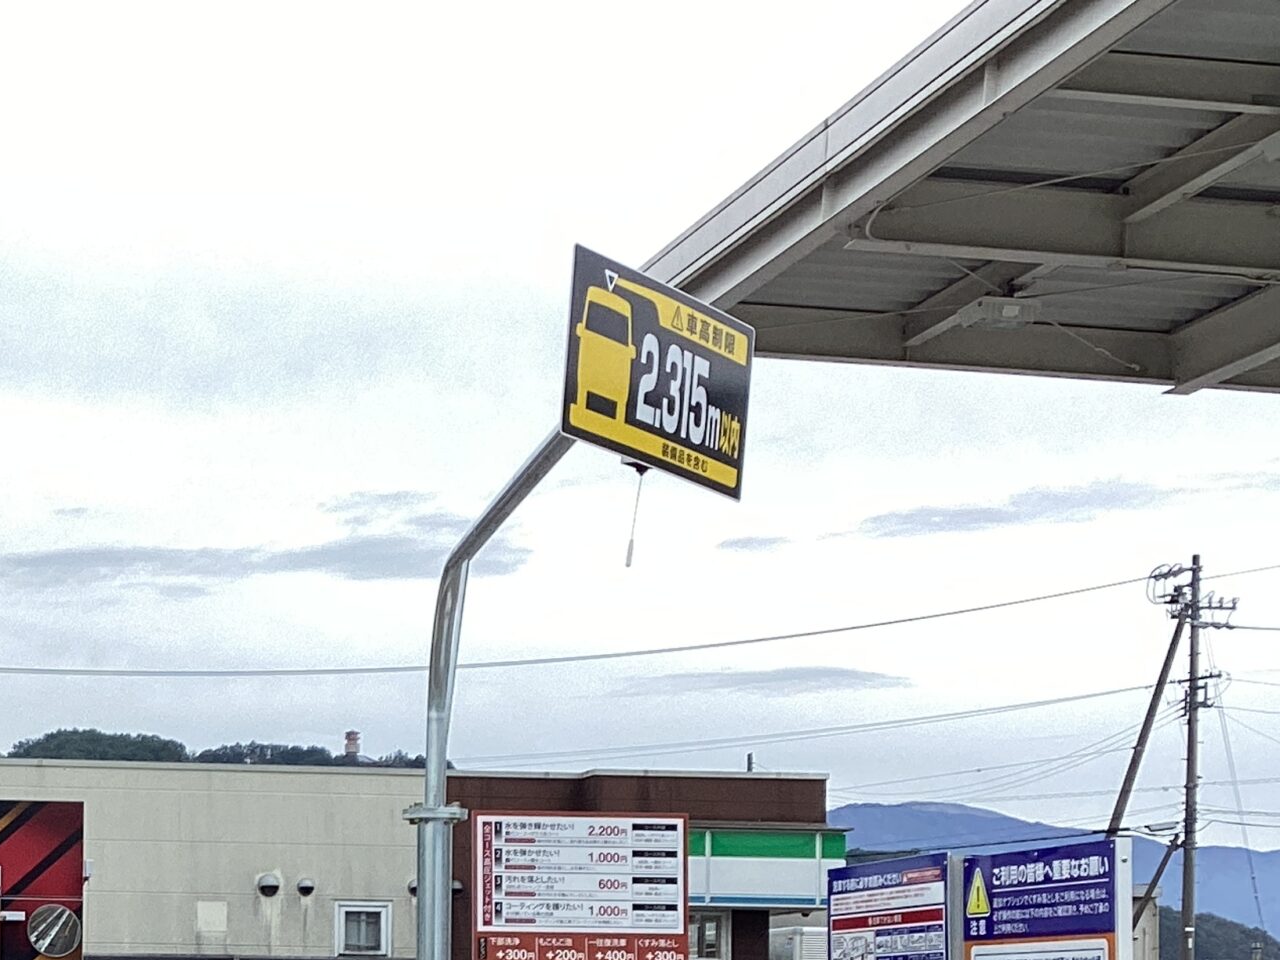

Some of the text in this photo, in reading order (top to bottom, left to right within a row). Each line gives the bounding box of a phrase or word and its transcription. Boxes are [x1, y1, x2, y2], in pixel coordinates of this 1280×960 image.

[686, 313, 735, 355] 車高制限
[661, 442, 709, 473] 装備品を含む
[588, 825, 628, 836] 2,200円
[588, 852, 628, 863] 1,000円
[599, 879, 628, 890] 600円
[588, 905, 628, 917] 1,000円
